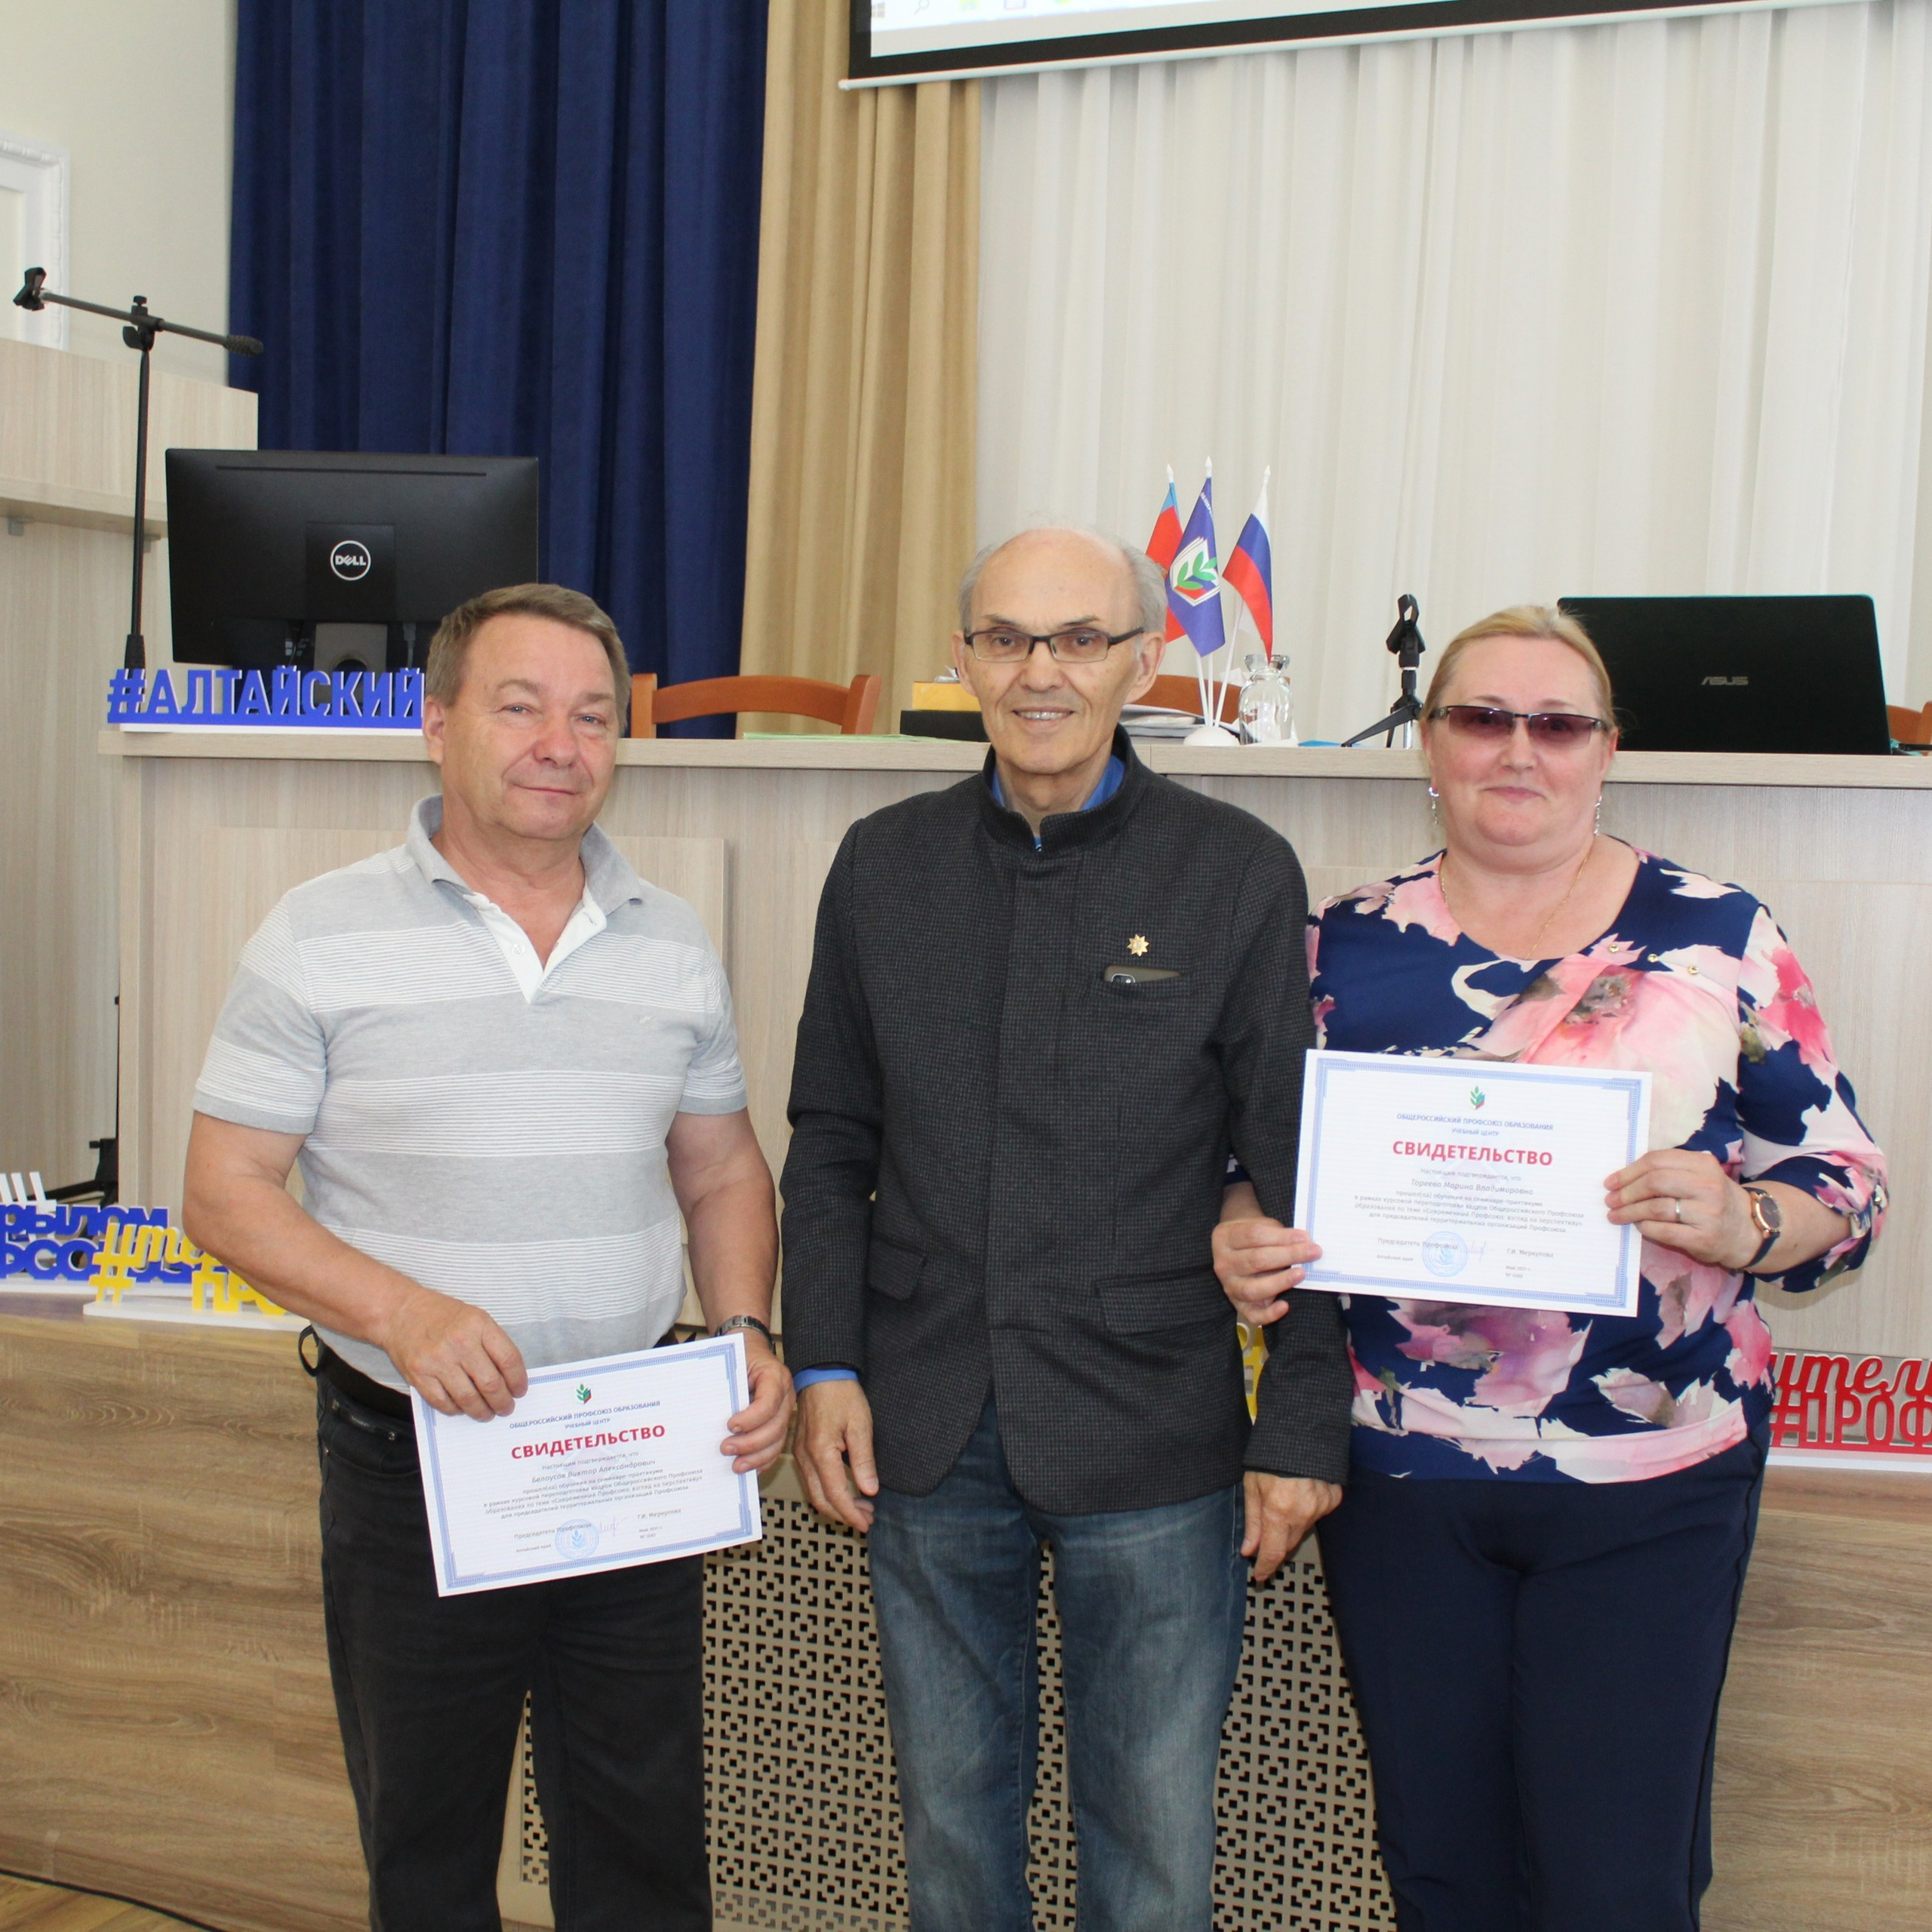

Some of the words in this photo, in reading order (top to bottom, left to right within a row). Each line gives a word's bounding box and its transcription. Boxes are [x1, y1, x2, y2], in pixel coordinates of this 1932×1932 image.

[334, 554, 367, 568] DELL
[1700, 675, 1749, 686] ASUS
[107, 665, 425, 726] #АЛТАЙСКИЙ
[1396, 1113, 1462, 1124] ОБЩЕРОССИЙСКИЙ
[1463, 1118, 1503, 1127] ПРОФСОЮЗ
[1504, 1121, 1553, 1131] ОБРАЗОВАНИЯ
[1392, 1141, 1552, 1166] СВИДЕТЕЛЬСТВО
[1443, 1181, 1474, 1191] Марина
[1475, 1183, 1533, 1195] Владимировна
[1770, 1353, 1932, 1398] ител
[509, 1414, 573, 1429] ОБЩЕРОССИЙСКИЙ
[574, 1407, 612, 1420] ПРОФСОЮЗ
[613, 1401, 660, 1413] ОБРАЗОВАНИЯ
[565, 1420, 592, 1429] УЧЕБНЫЙ
[592, 1417, 611, 1426] ЦЕНТР
[512, 1425, 665, 1459] СВИДЕТЕЛЬСТВО
[531, 1473, 566, 1484] Белоусов
[568, 1468, 597, 1478] Виктор
[598, 1460, 655, 1473] Александрович
